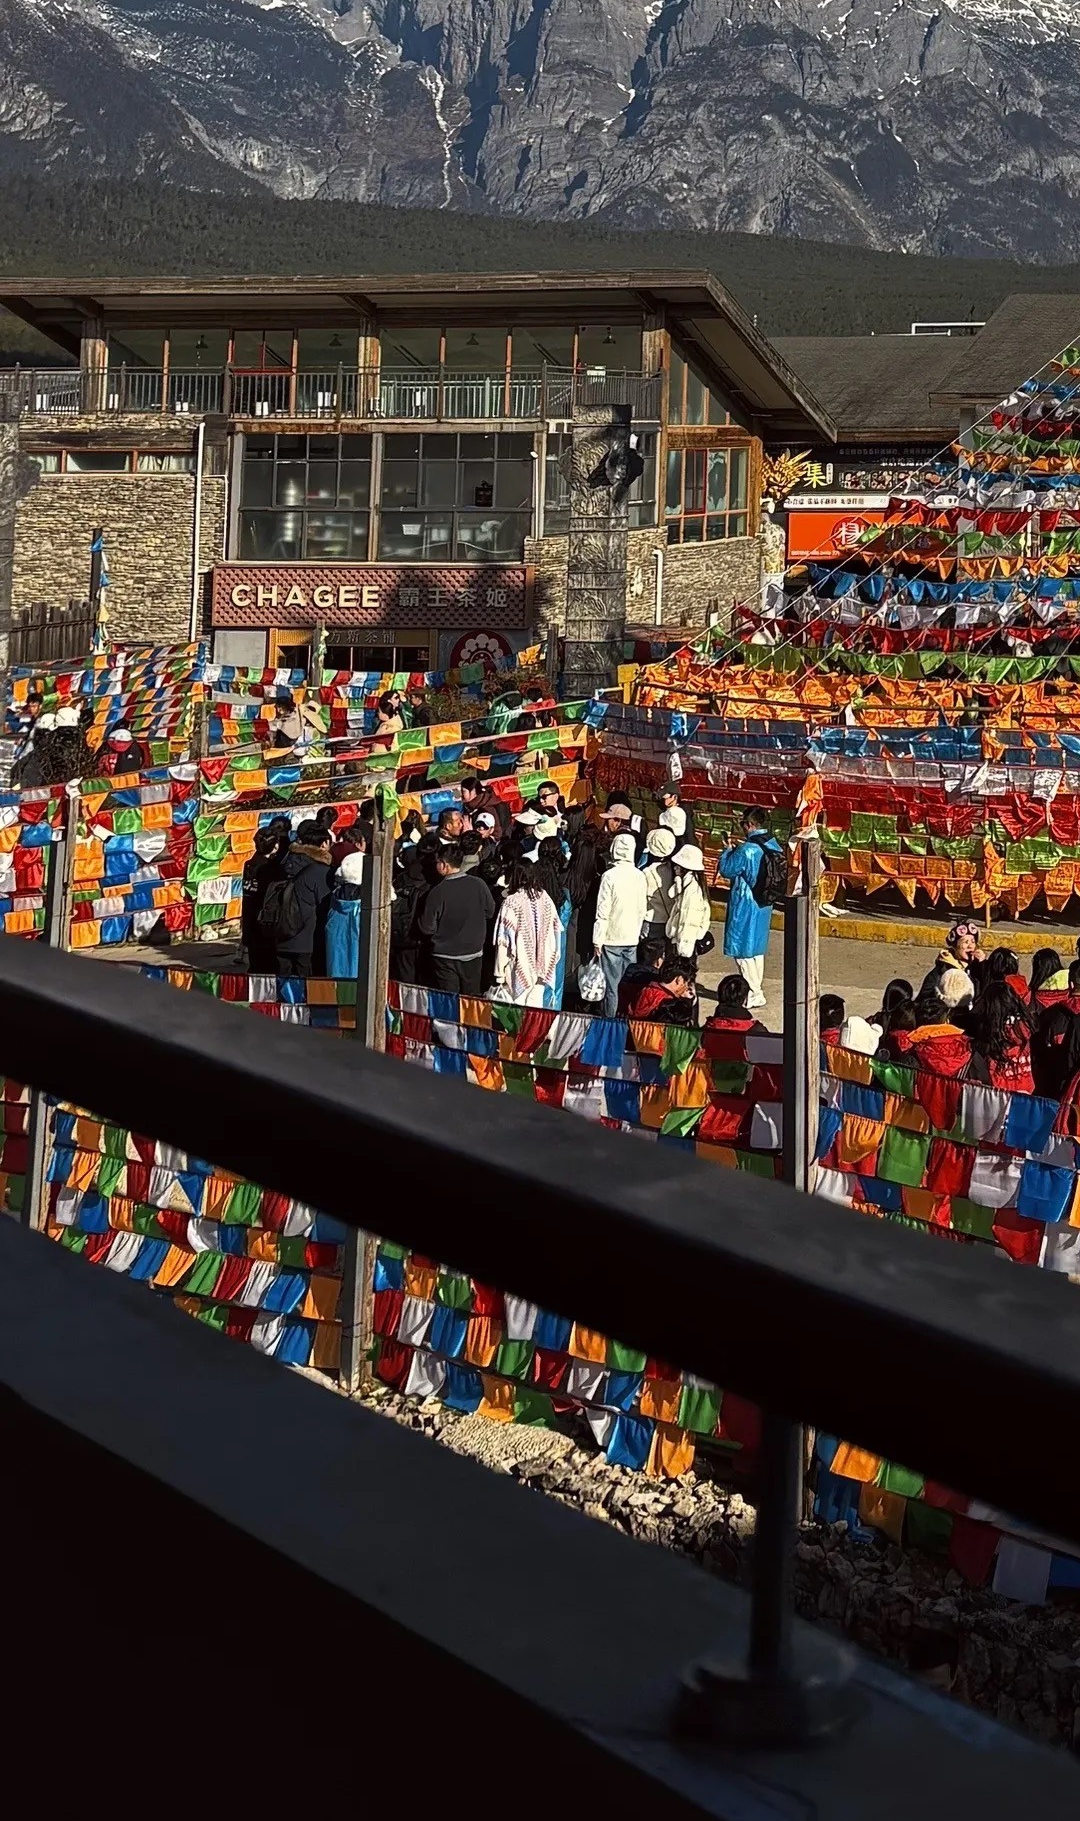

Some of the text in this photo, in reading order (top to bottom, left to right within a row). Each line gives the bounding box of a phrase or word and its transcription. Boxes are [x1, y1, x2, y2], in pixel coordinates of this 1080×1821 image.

[231, 584, 508, 608] CHAGEE 霸王茶姬
[327, 630, 396, 644] 方新茶铺
